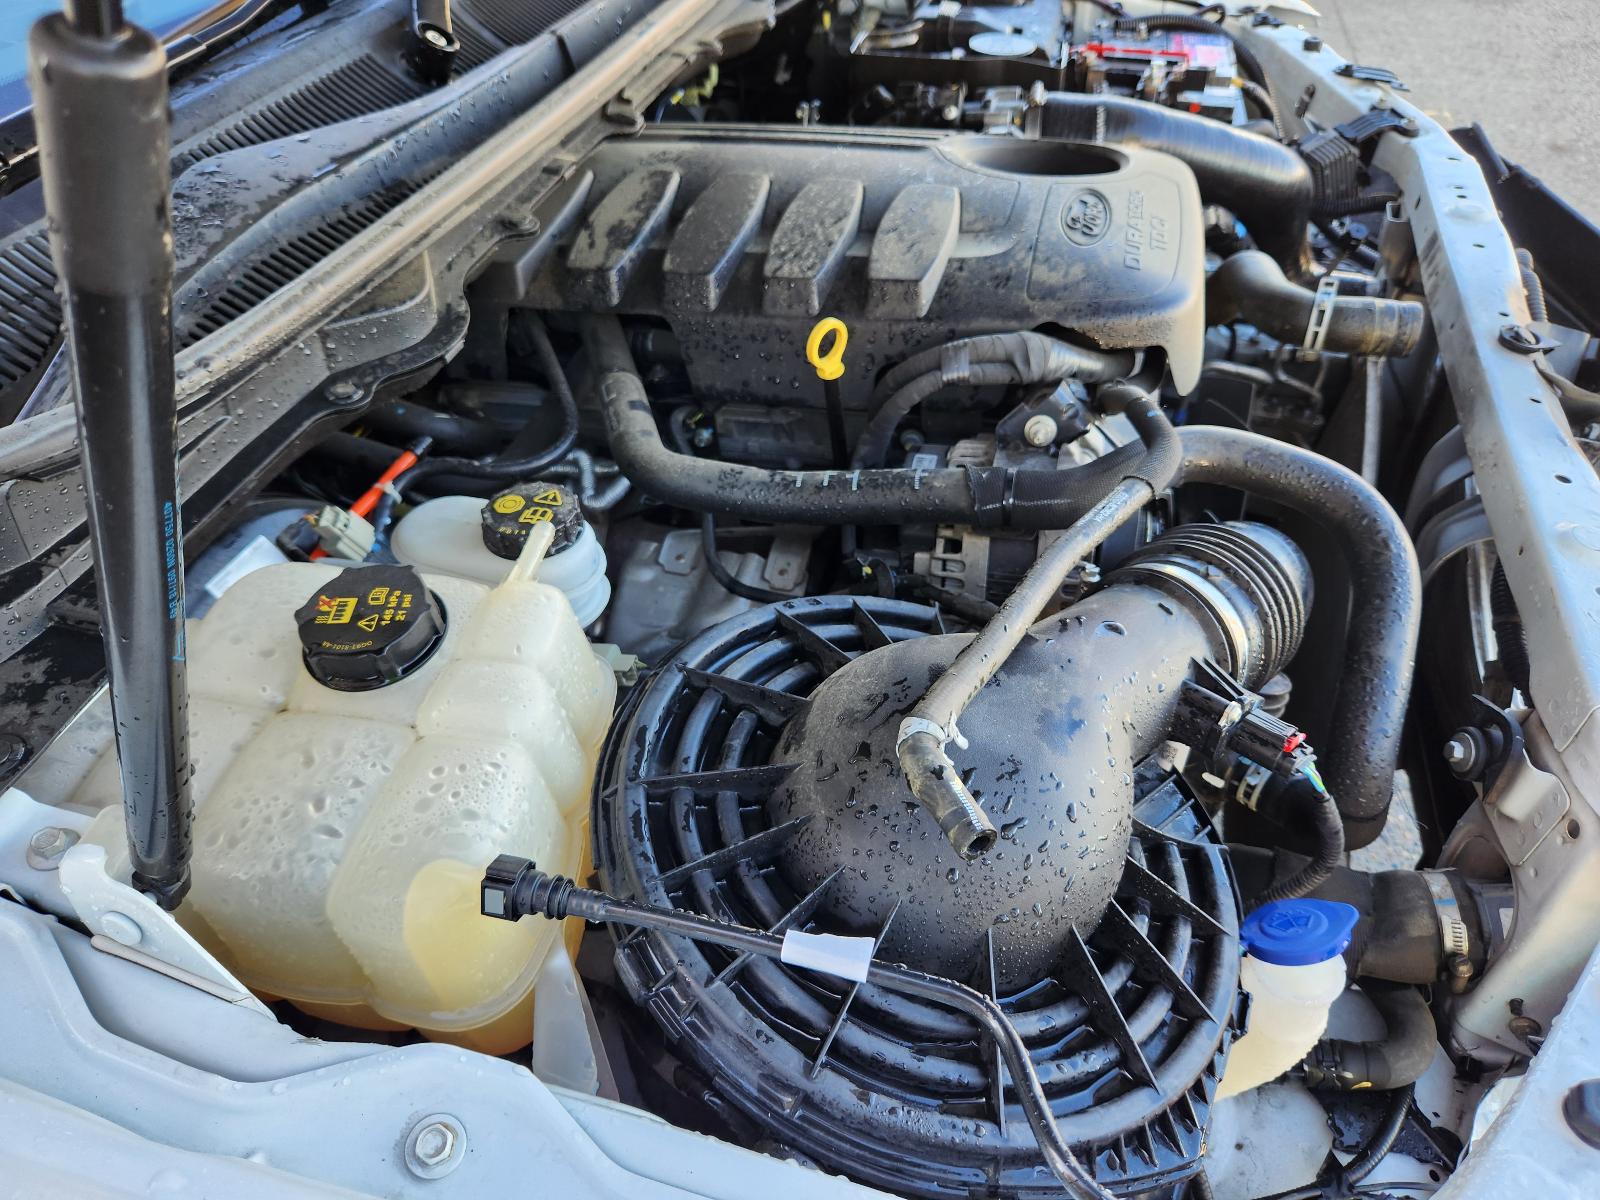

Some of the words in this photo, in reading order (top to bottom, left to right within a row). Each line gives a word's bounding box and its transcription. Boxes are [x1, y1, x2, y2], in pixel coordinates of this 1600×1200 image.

[387, 590, 402, 607] kPa
[395, 610, 407, 621] 21
[401, 594, 413, 608] psi
[380, 608, 395, 626] 145
